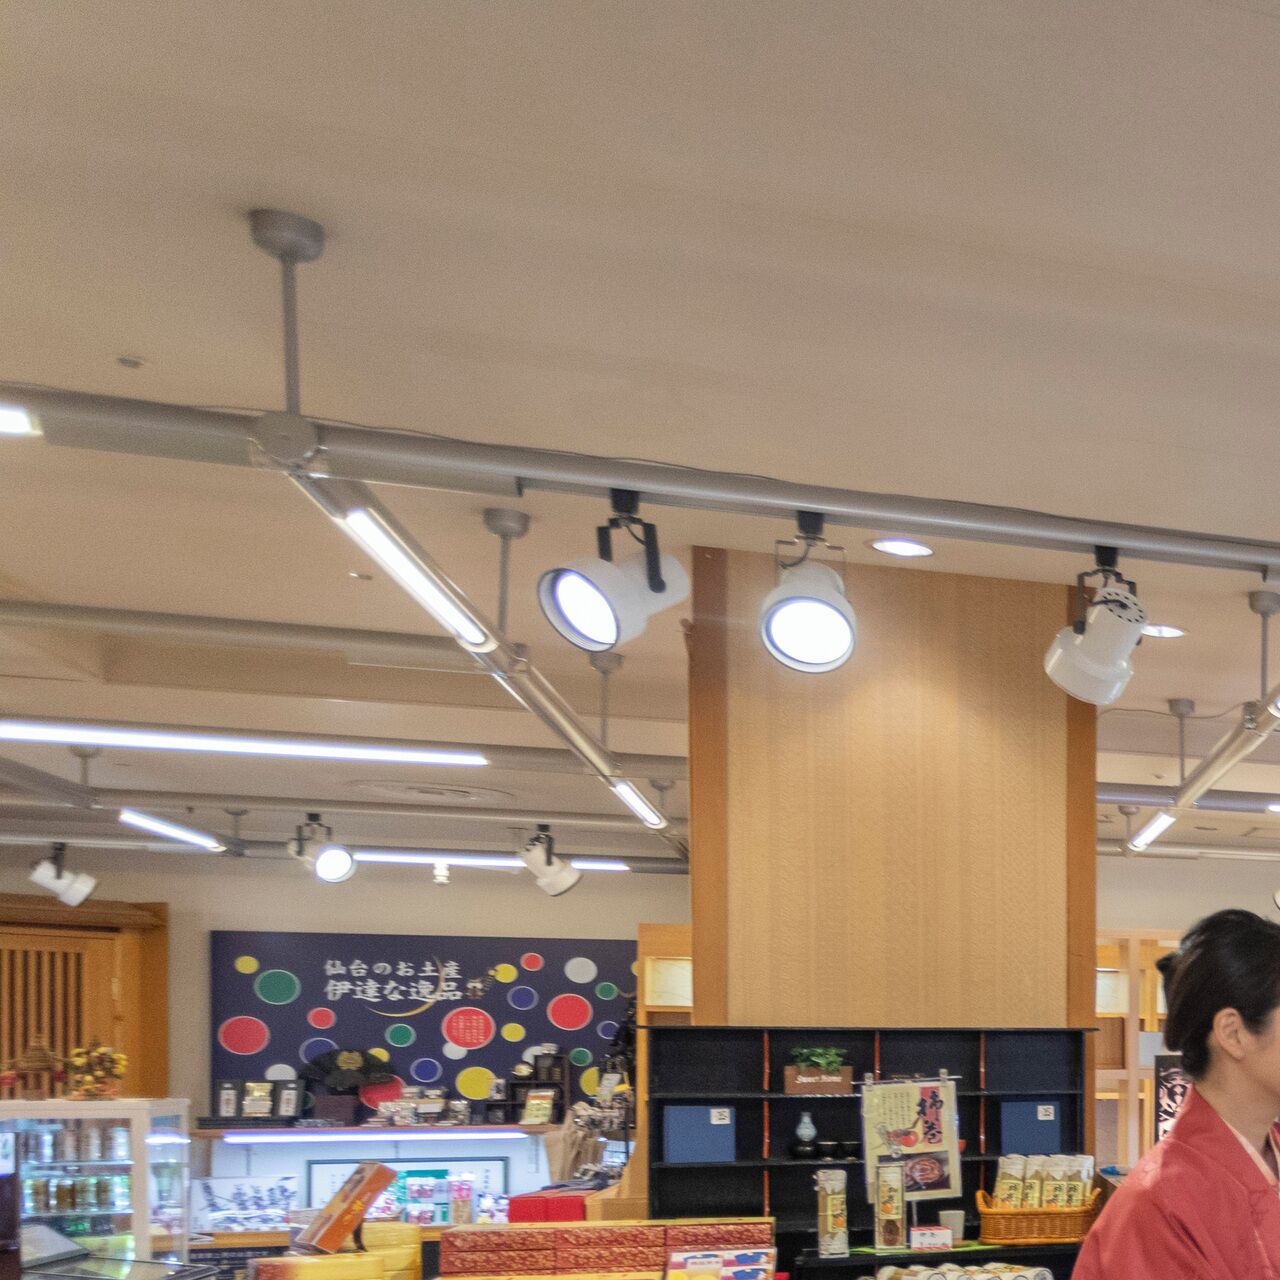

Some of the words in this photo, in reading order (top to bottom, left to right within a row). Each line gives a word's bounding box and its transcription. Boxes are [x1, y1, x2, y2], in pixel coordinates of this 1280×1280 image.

[324, 960, 463, 979] 仙台のお土産
[324, 978, 464, 1003] 伊達な逸品
